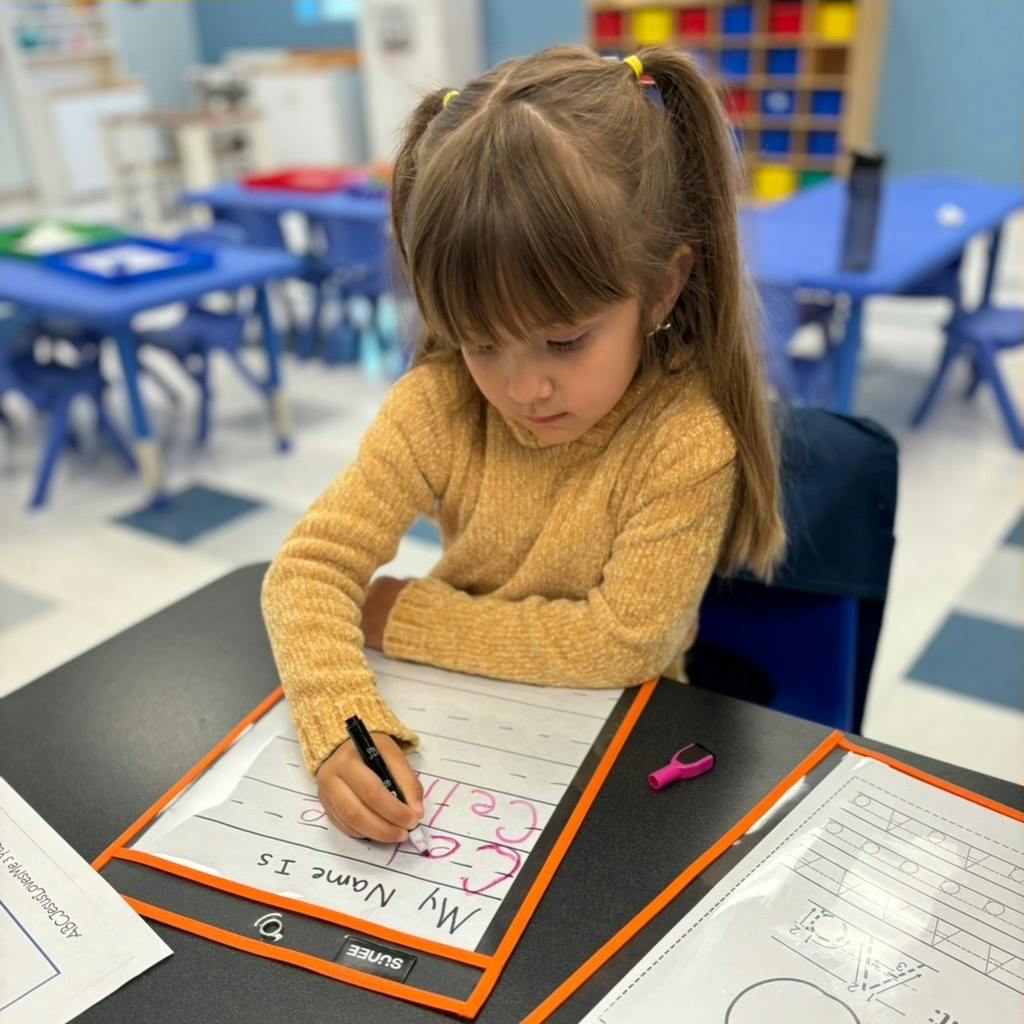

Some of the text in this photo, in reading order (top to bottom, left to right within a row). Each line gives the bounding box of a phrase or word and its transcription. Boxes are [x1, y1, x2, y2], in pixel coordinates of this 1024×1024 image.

[256, 852, 482, 935] My Name Is
